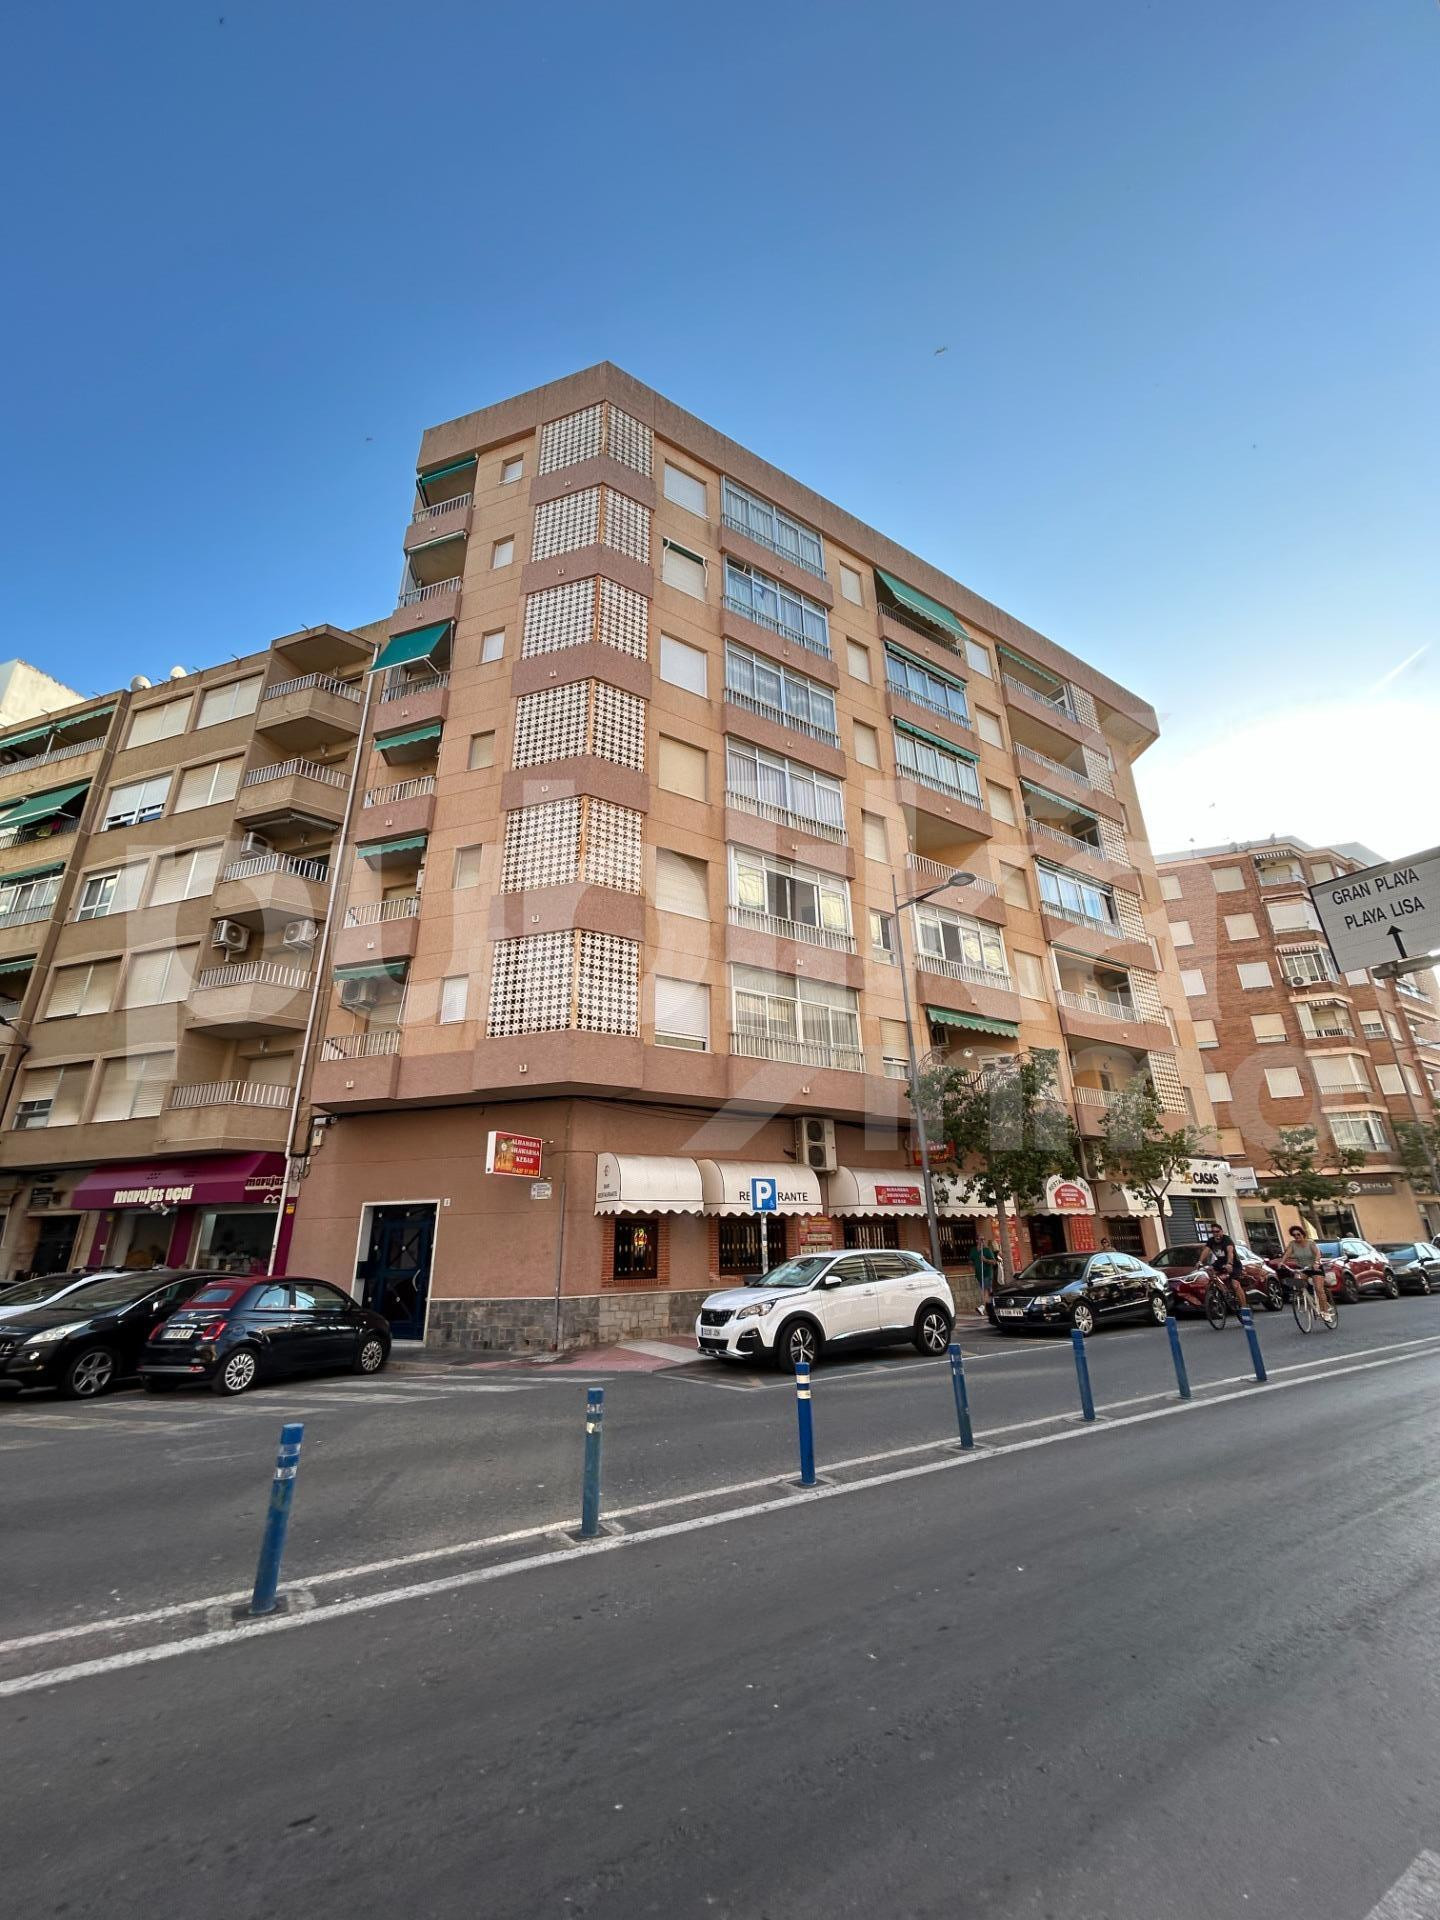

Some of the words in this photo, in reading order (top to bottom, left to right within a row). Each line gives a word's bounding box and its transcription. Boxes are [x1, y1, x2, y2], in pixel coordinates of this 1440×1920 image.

[1332, 881, 1371, 905] GRAN
[1375, 868, 1419, 893] PLAYA
[1344, 907, 1387, 930] PLAYA
[1390, 896, 1425, 917] LISA
[511, 1138, 540, 1148] ALHAMBRA
[516, 1155, 534, 1164] KEBAB
[245, 1175, 284, 1191] marujas
[1193, 1172, 1219, 1184] CASAS
[1362, 1182, 1392, 1190] SEVILLA
[113, 1186, 165, 1204] marujas
[165, 1184, 195, 1204] açaí
[739, 1191, 809, 1202] RERANTE
[756, 1180, 772, 1209] P
